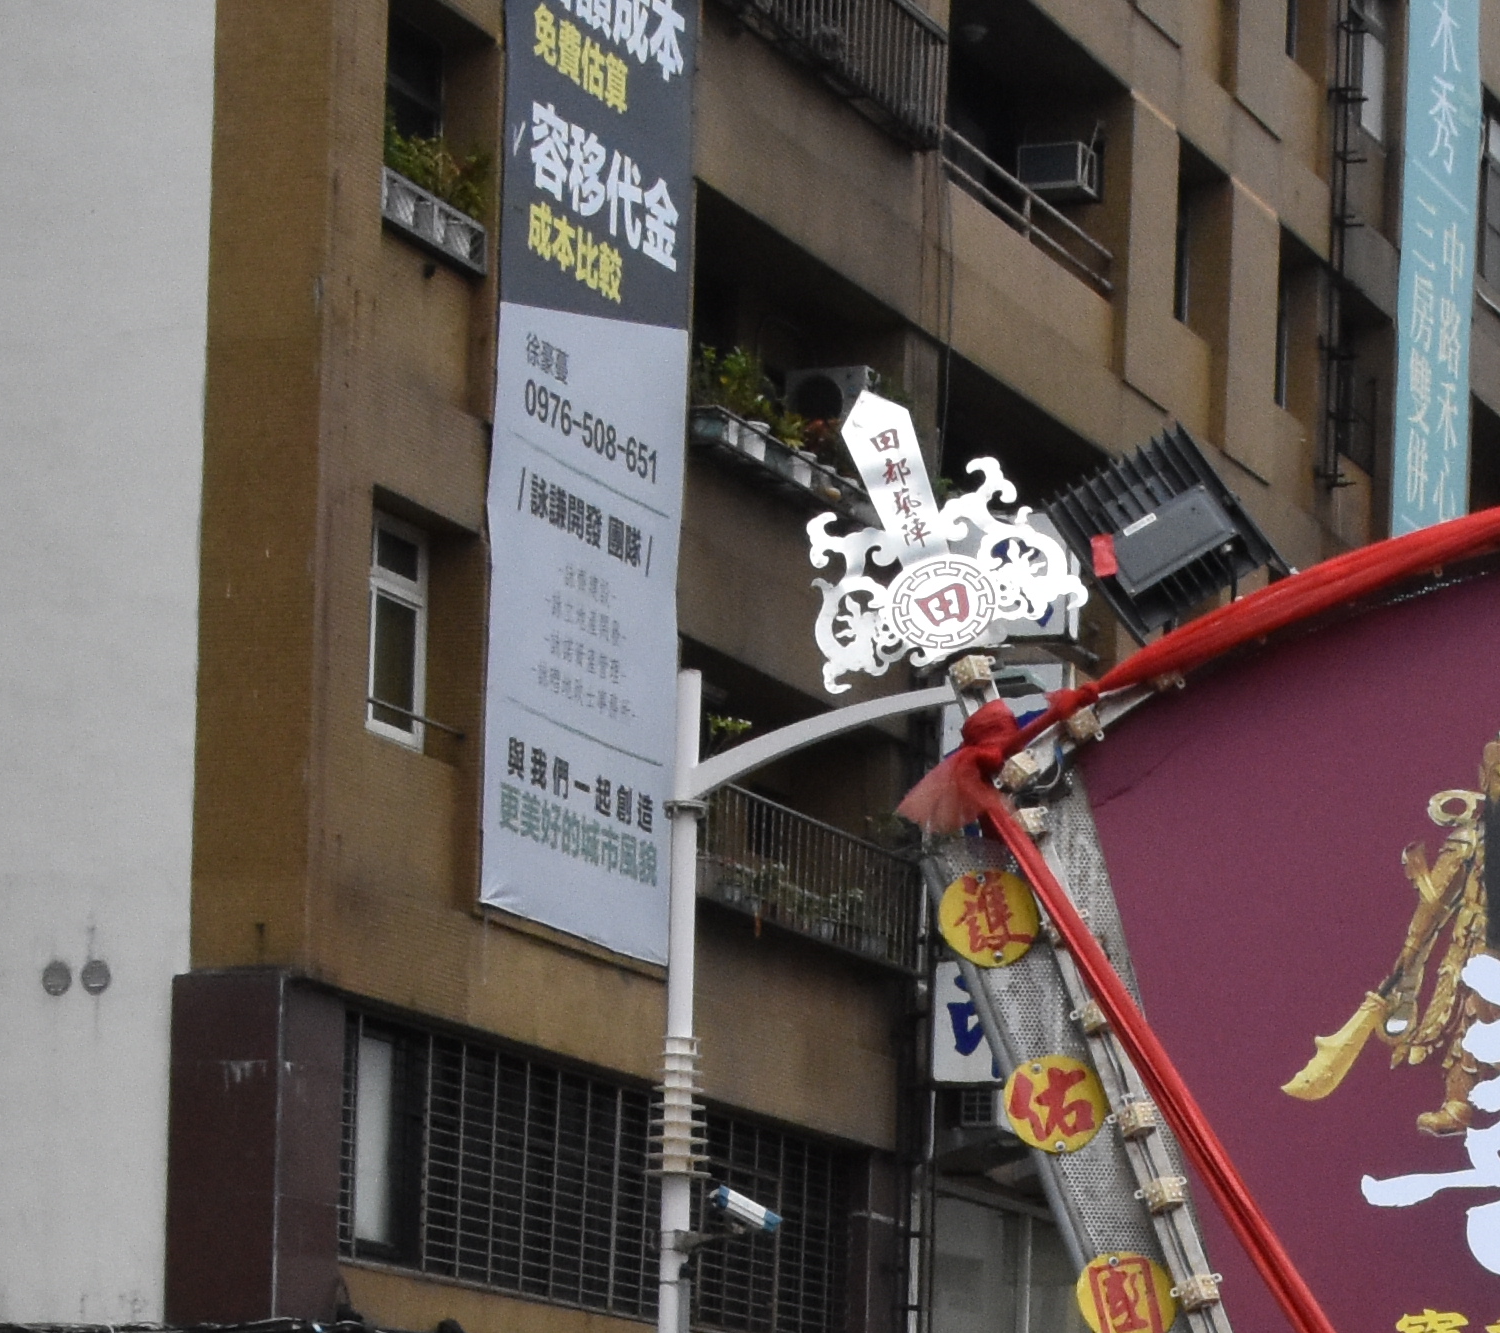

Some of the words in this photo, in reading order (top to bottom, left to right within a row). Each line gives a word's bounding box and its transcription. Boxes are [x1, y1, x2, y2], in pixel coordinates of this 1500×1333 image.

[534, 2, 628, 114] 免費估算
[531, 101, 679, 272] 容移代金
[528, 201, 622, 304] 成本比較
[524, 379, 657, 484] 0976-508-651
[915, 583, 968, 627] 田
[508, 737, 652, 833] 與我們一起創造
